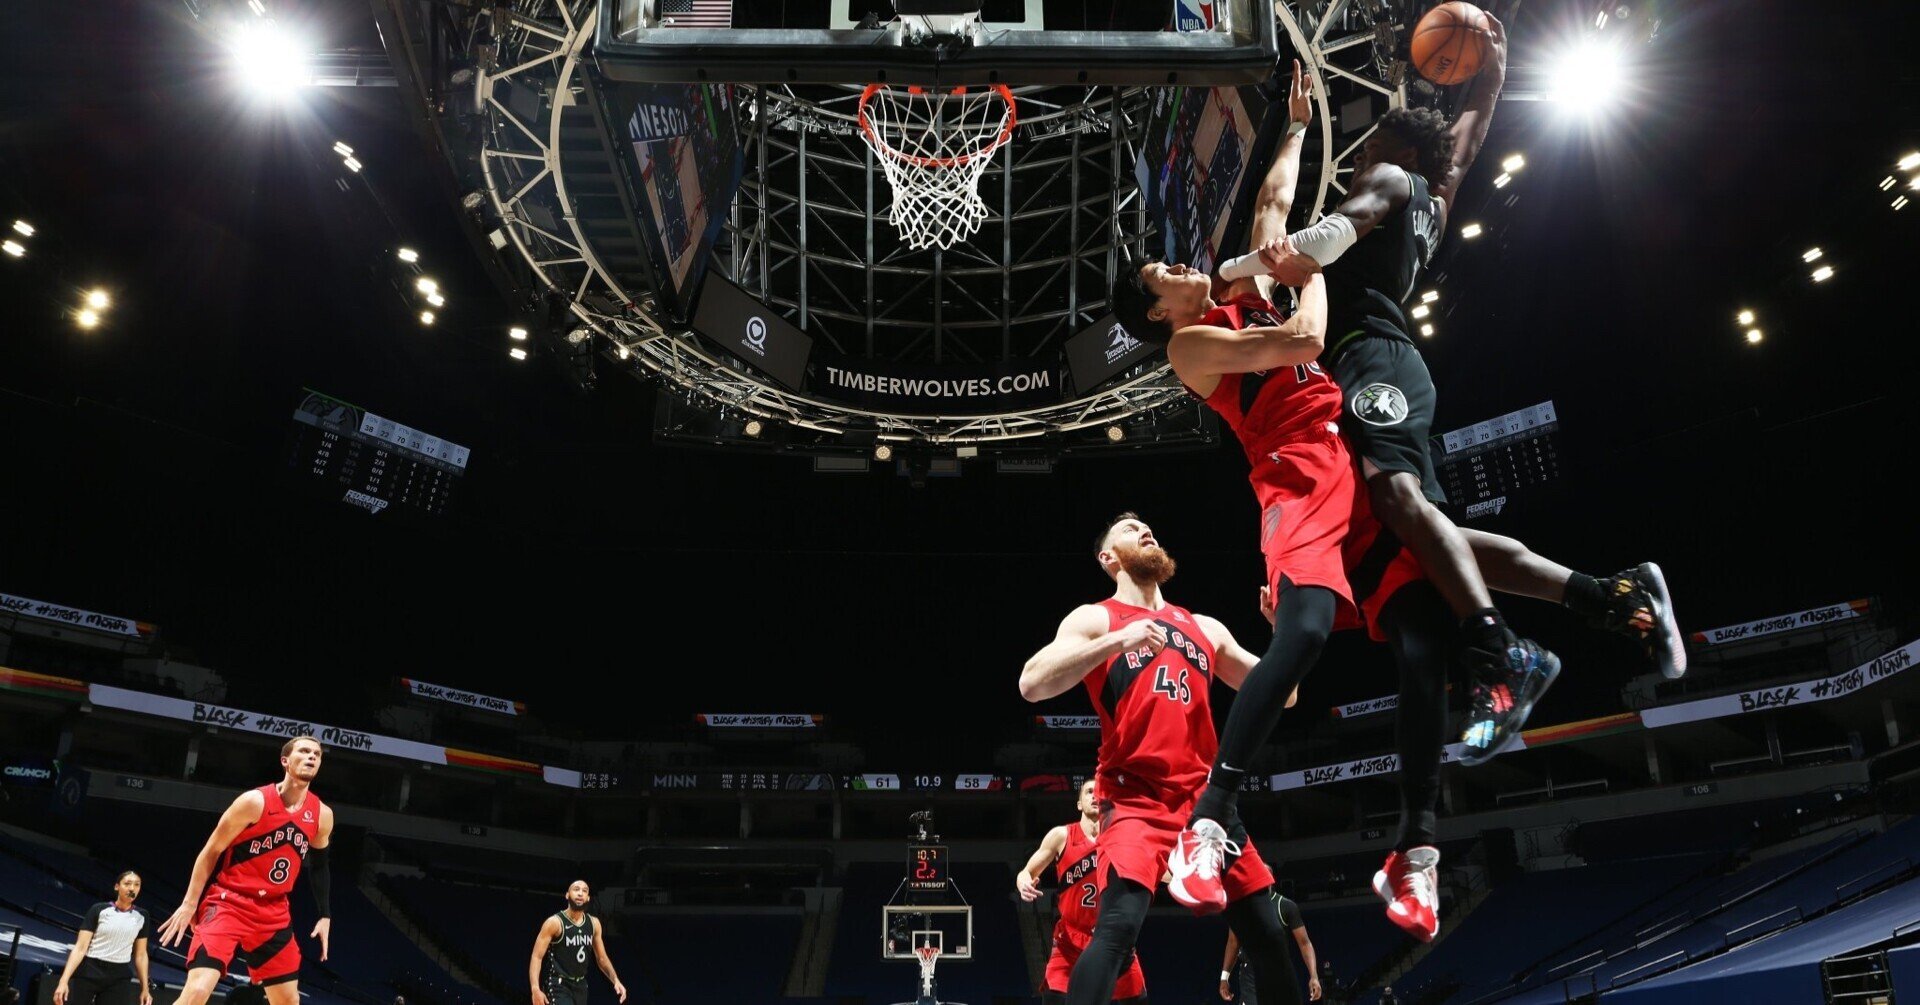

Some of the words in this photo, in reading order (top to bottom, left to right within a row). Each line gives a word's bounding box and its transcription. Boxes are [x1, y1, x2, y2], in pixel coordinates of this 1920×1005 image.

[1182, 18, 1200, 30] NBA
[827, 367, 1049, 396] TIMBERWOLVES.COM
[346, 489, 388, 508] FEDERATED
[1466, 496, 1507, 514] FEDERATED
[1125, 627, 1208, 670] RAORS
[1153, 665, 1190, 704] 46
[4, 766, 51, 779] CRUNCH
[126, 778, 144, 788] 136
[613, 777, 618, 785] 2
[654, 774, 696, 788] MINN
[876, 778, 890, 788] 61
[914, 776, 941, 787] 10.9
[964, 778, 980, 788] 58
[1692, 785, 1709, 794] 106
[250, 828, 308, 859] RAPTOR
[918, 850, 936, 860] 10.7
[269, 858, 291, 884] 8
[916, 861, 936, 878] 2.2
[1082, 882, 1097, 907] 2
[566, 934, 593, 946] MINN
[576, 946, 586, 963] 6
